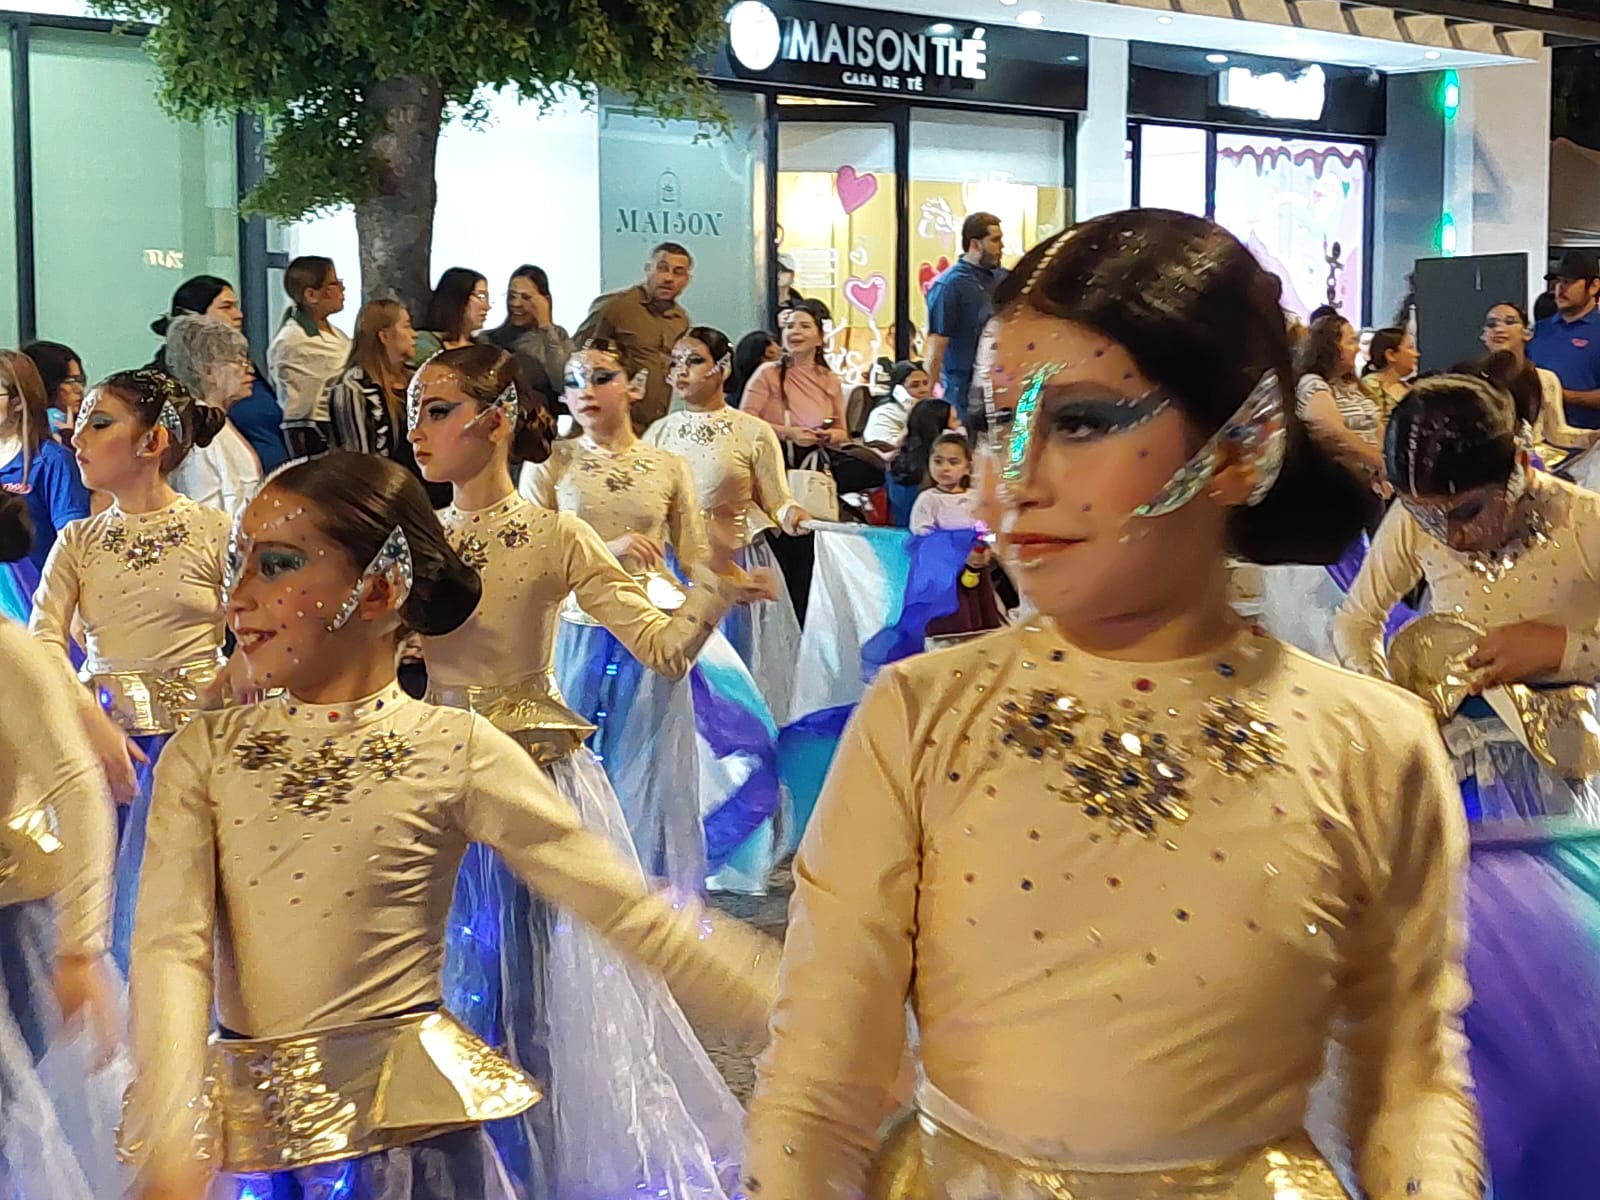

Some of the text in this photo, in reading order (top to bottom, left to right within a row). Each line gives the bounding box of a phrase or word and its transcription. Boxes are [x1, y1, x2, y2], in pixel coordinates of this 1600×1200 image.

[788, 17, 987, 80] MAISON THÉ
[841, 71, 924, 91] CASA DE TÉ
[615, 207, 724, 236] MAISON
